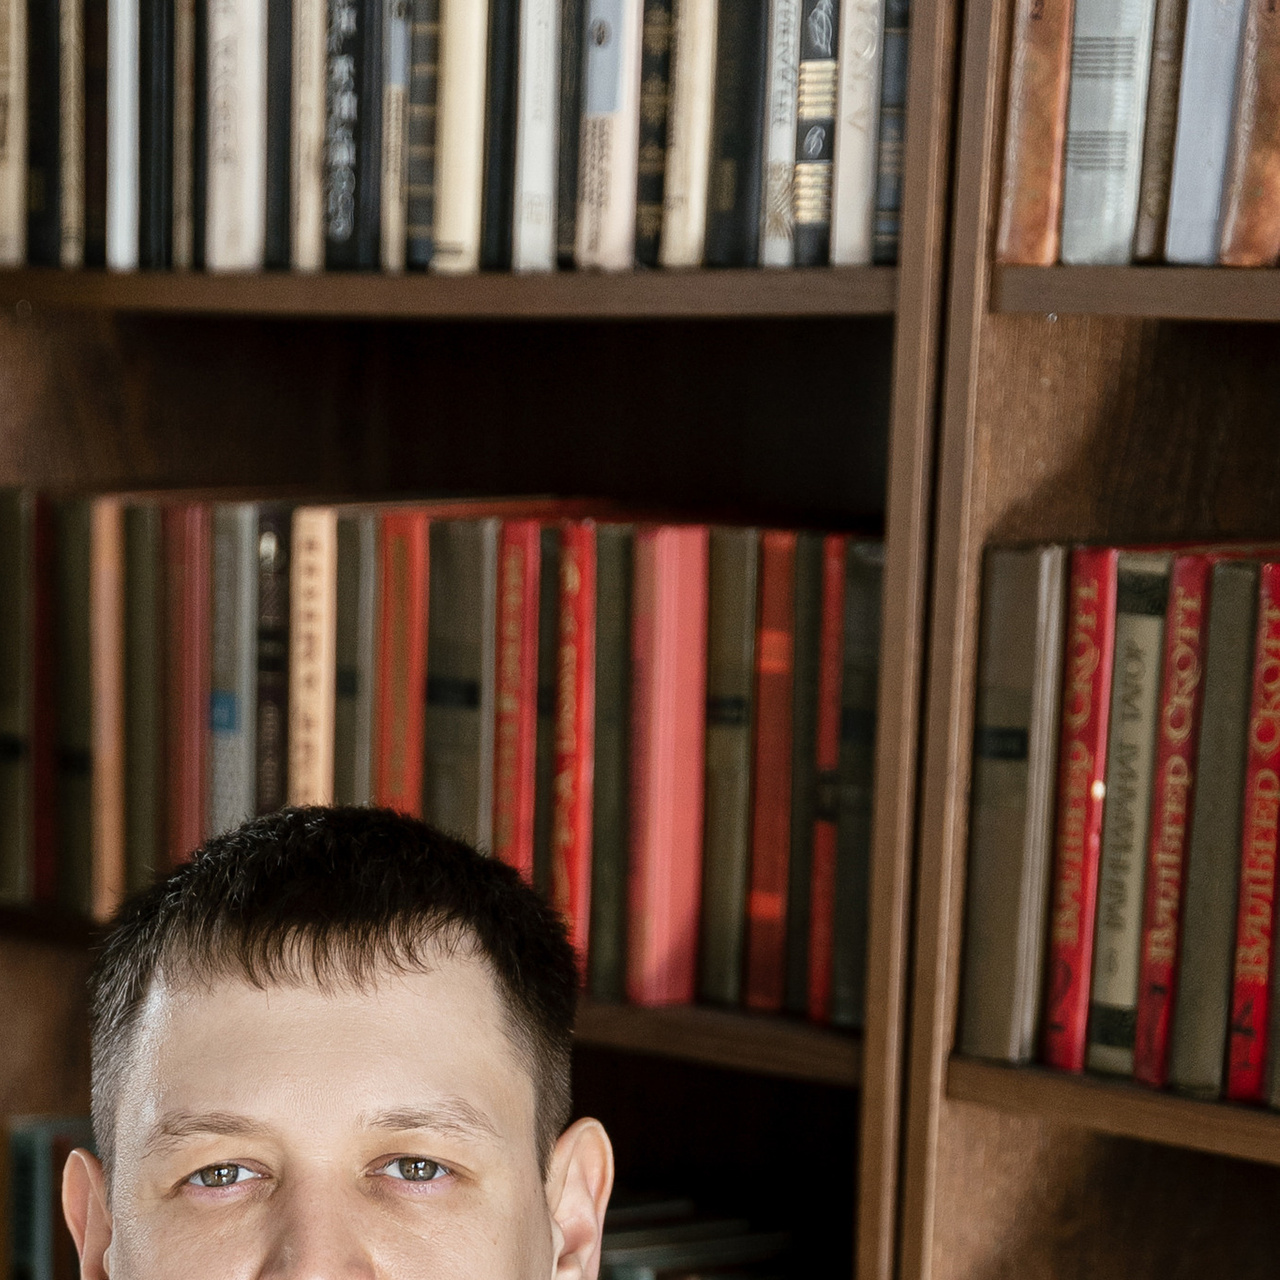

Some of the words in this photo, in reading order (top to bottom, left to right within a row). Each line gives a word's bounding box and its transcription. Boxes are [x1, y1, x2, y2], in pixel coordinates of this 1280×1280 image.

[1067, 578, 1101, 735] СКОТТ
[1163, 586, 1201, 745] СКОТТ
[1250, 597, 1280, 757] СКОТТ
[1147, 754, 1192, 963] ВАЛЬТЕР
[1234, 767, 1280, 983] ВАЛЬТЕР
